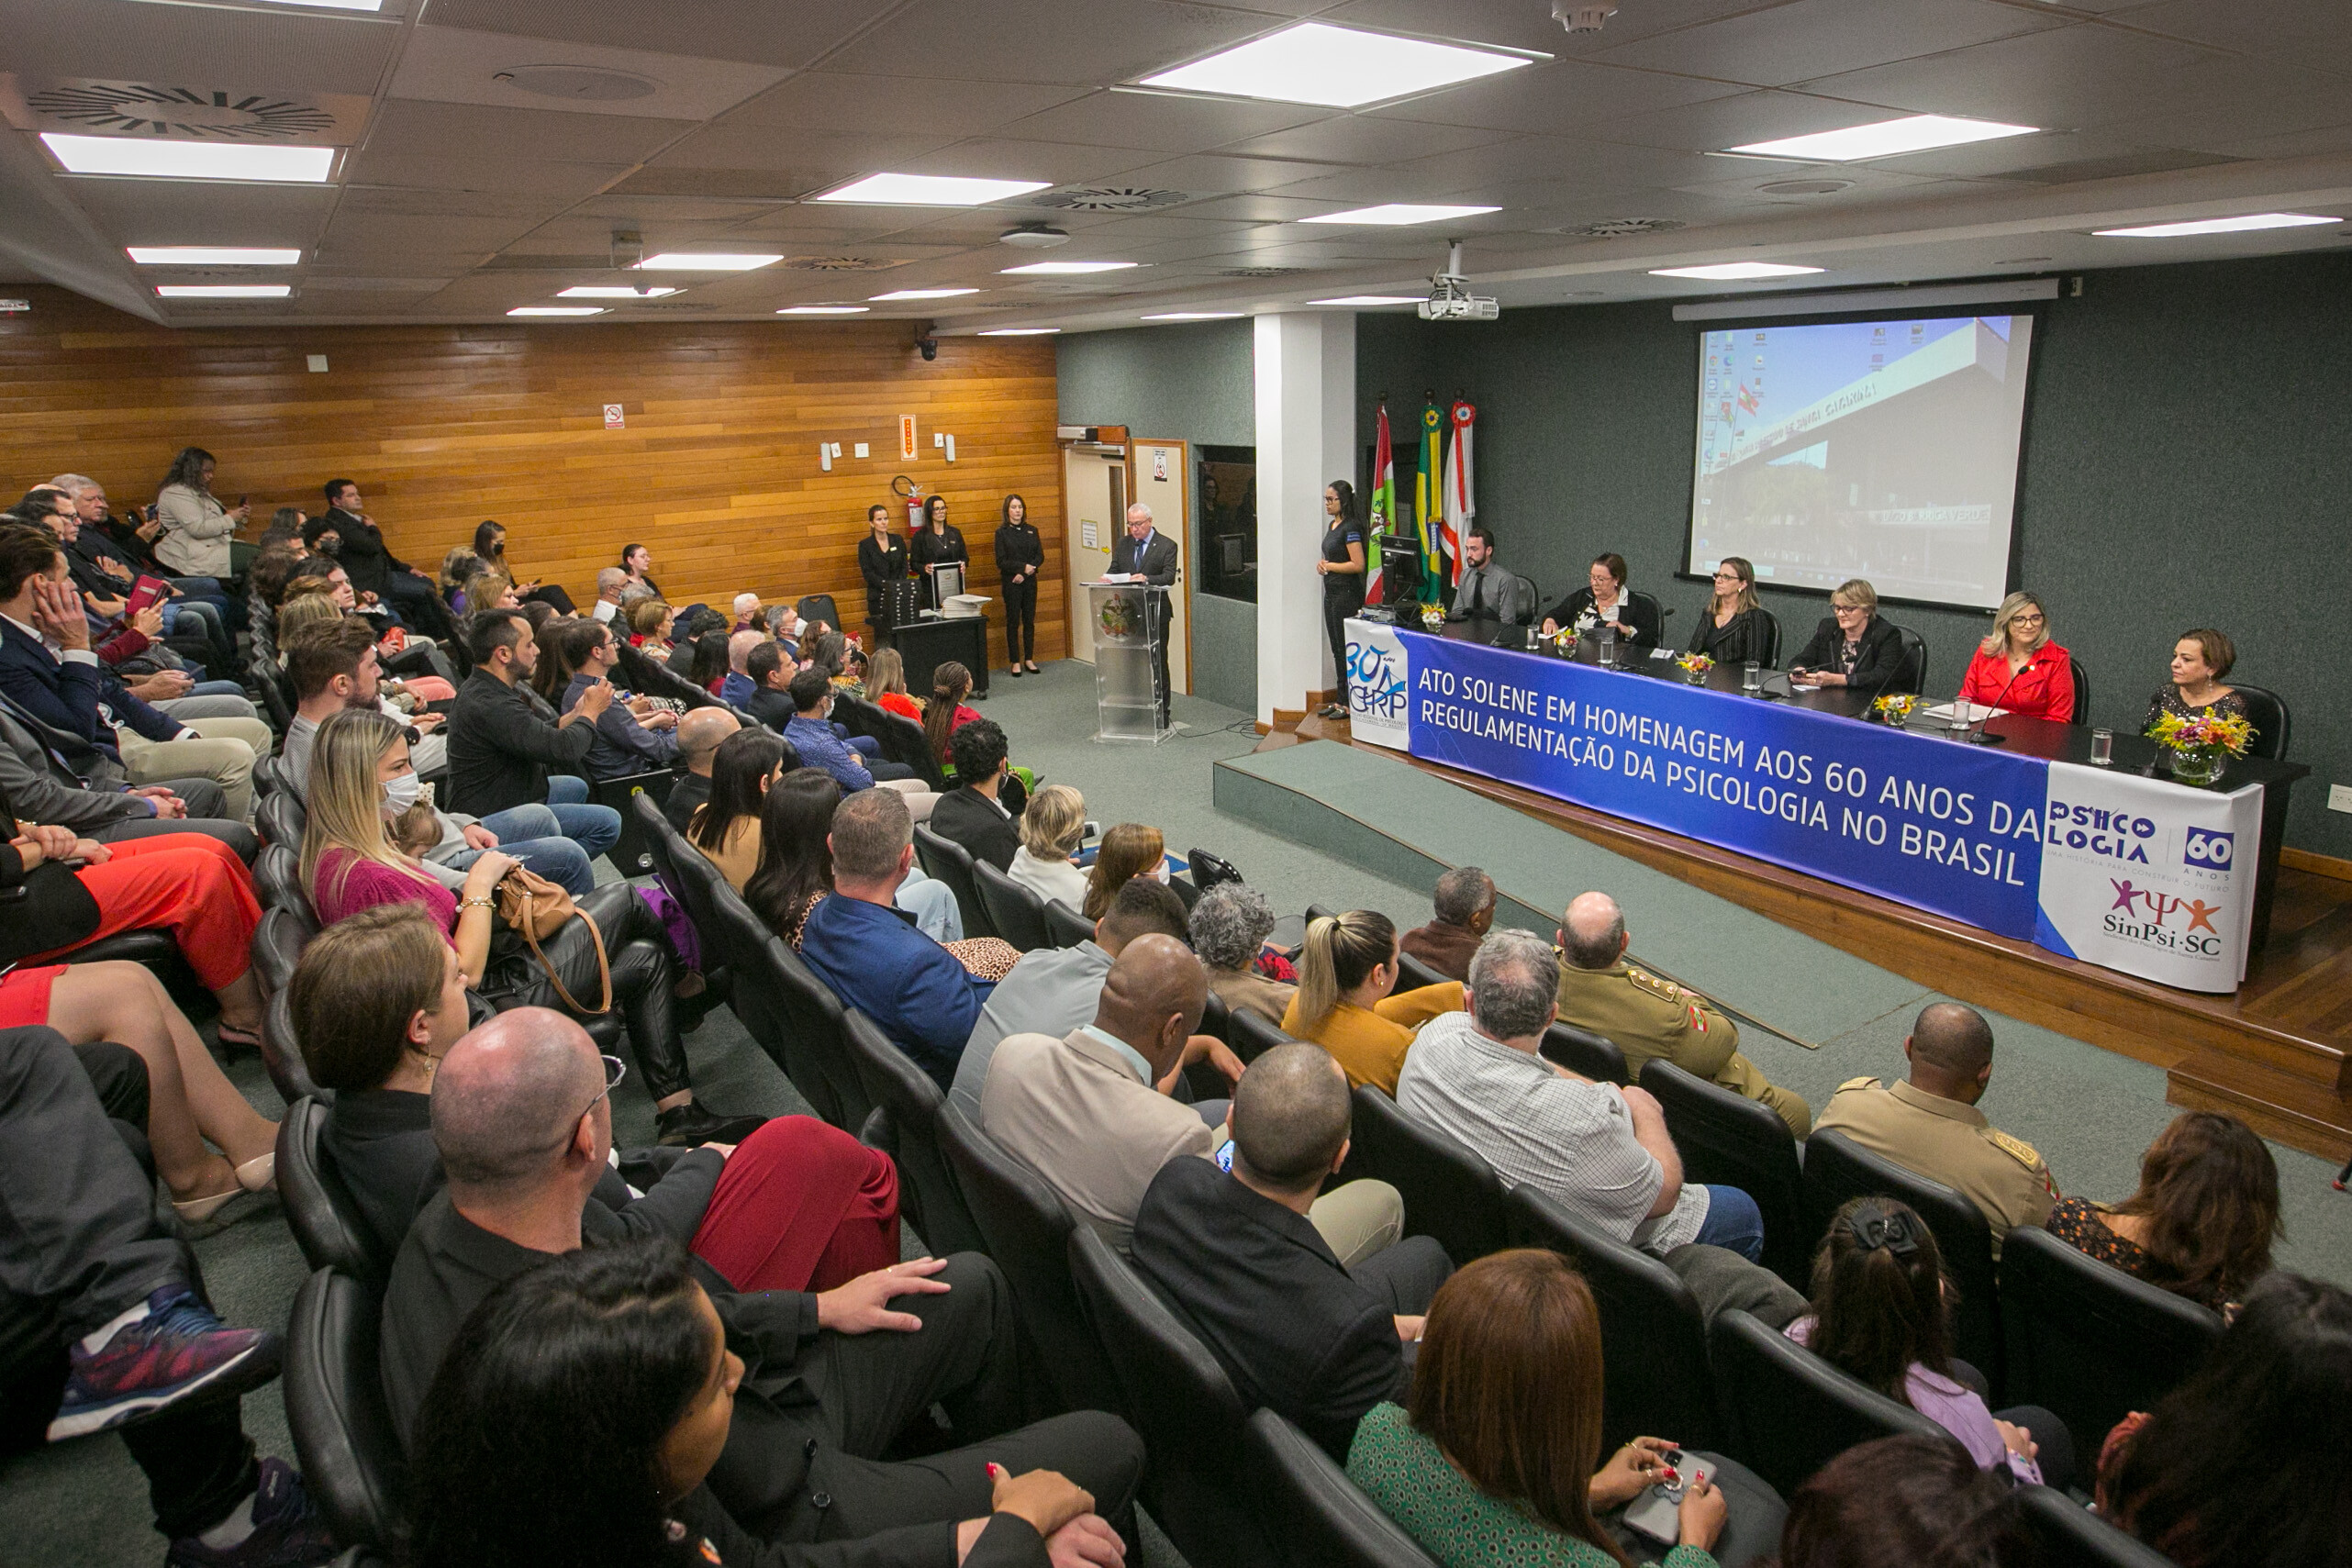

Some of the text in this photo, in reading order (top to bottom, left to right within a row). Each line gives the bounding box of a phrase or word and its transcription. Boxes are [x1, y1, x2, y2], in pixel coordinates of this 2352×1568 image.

[1350, 685, 1407, 719] CRP
[1418, 667, 2041, 843] ATO SOLENE EM HOMENAGEM AOS 60 ANOS DA
[1421, 699, 2025, 887] REGULAMENTAÇÃO DA PSICOLOGIA NO BRASIL
[2047, 824, 2149, 865] LOGIA
[2186, 833, 2233, 864] 60
[2045, 849, 2063, 859] UMA
[2107, 862, 2126, 872] PARA
[2132, 867, 2179, 884] CONSTRUIR
[2194, 882, 2230, 894] FUTURO
[2183, 867, 2230, 882] ANOS
